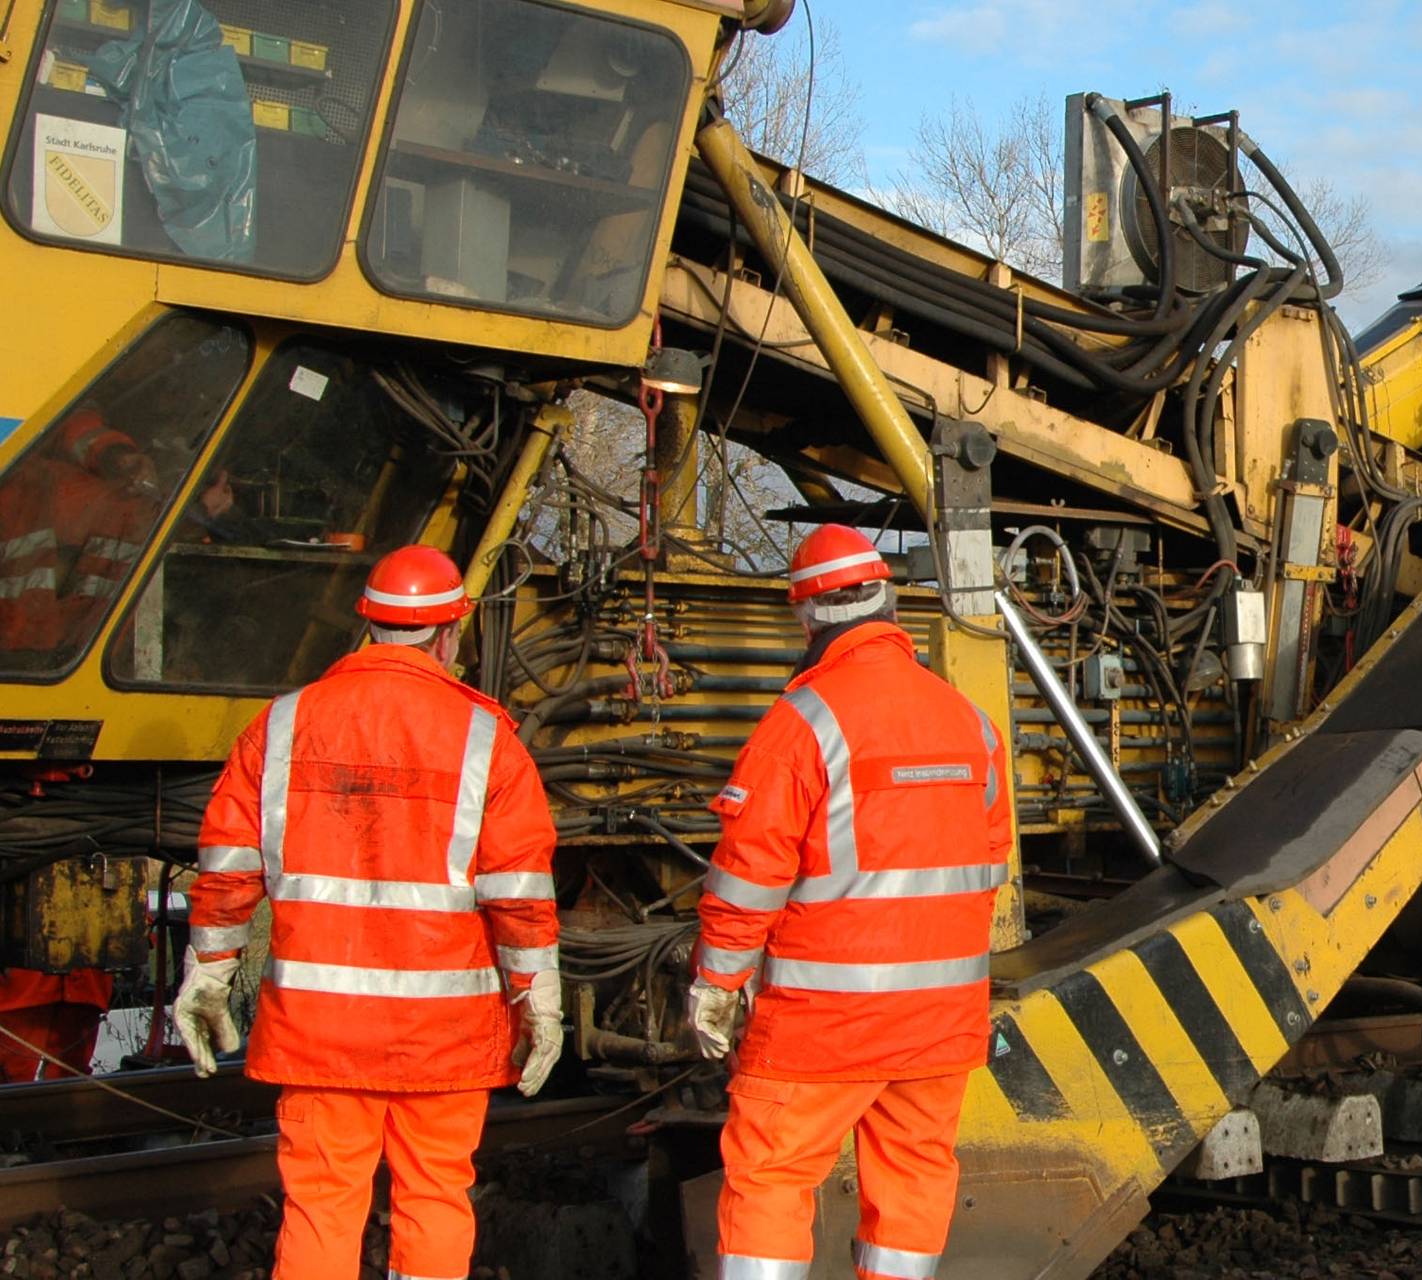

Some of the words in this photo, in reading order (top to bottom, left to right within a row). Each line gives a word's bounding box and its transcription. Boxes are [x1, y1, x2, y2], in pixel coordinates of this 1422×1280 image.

[45, 135, 71, 148] Stadt
[73, 139, 117, 155] Karlsruhe
[48, 155, 109, 224] FIDELITAS
